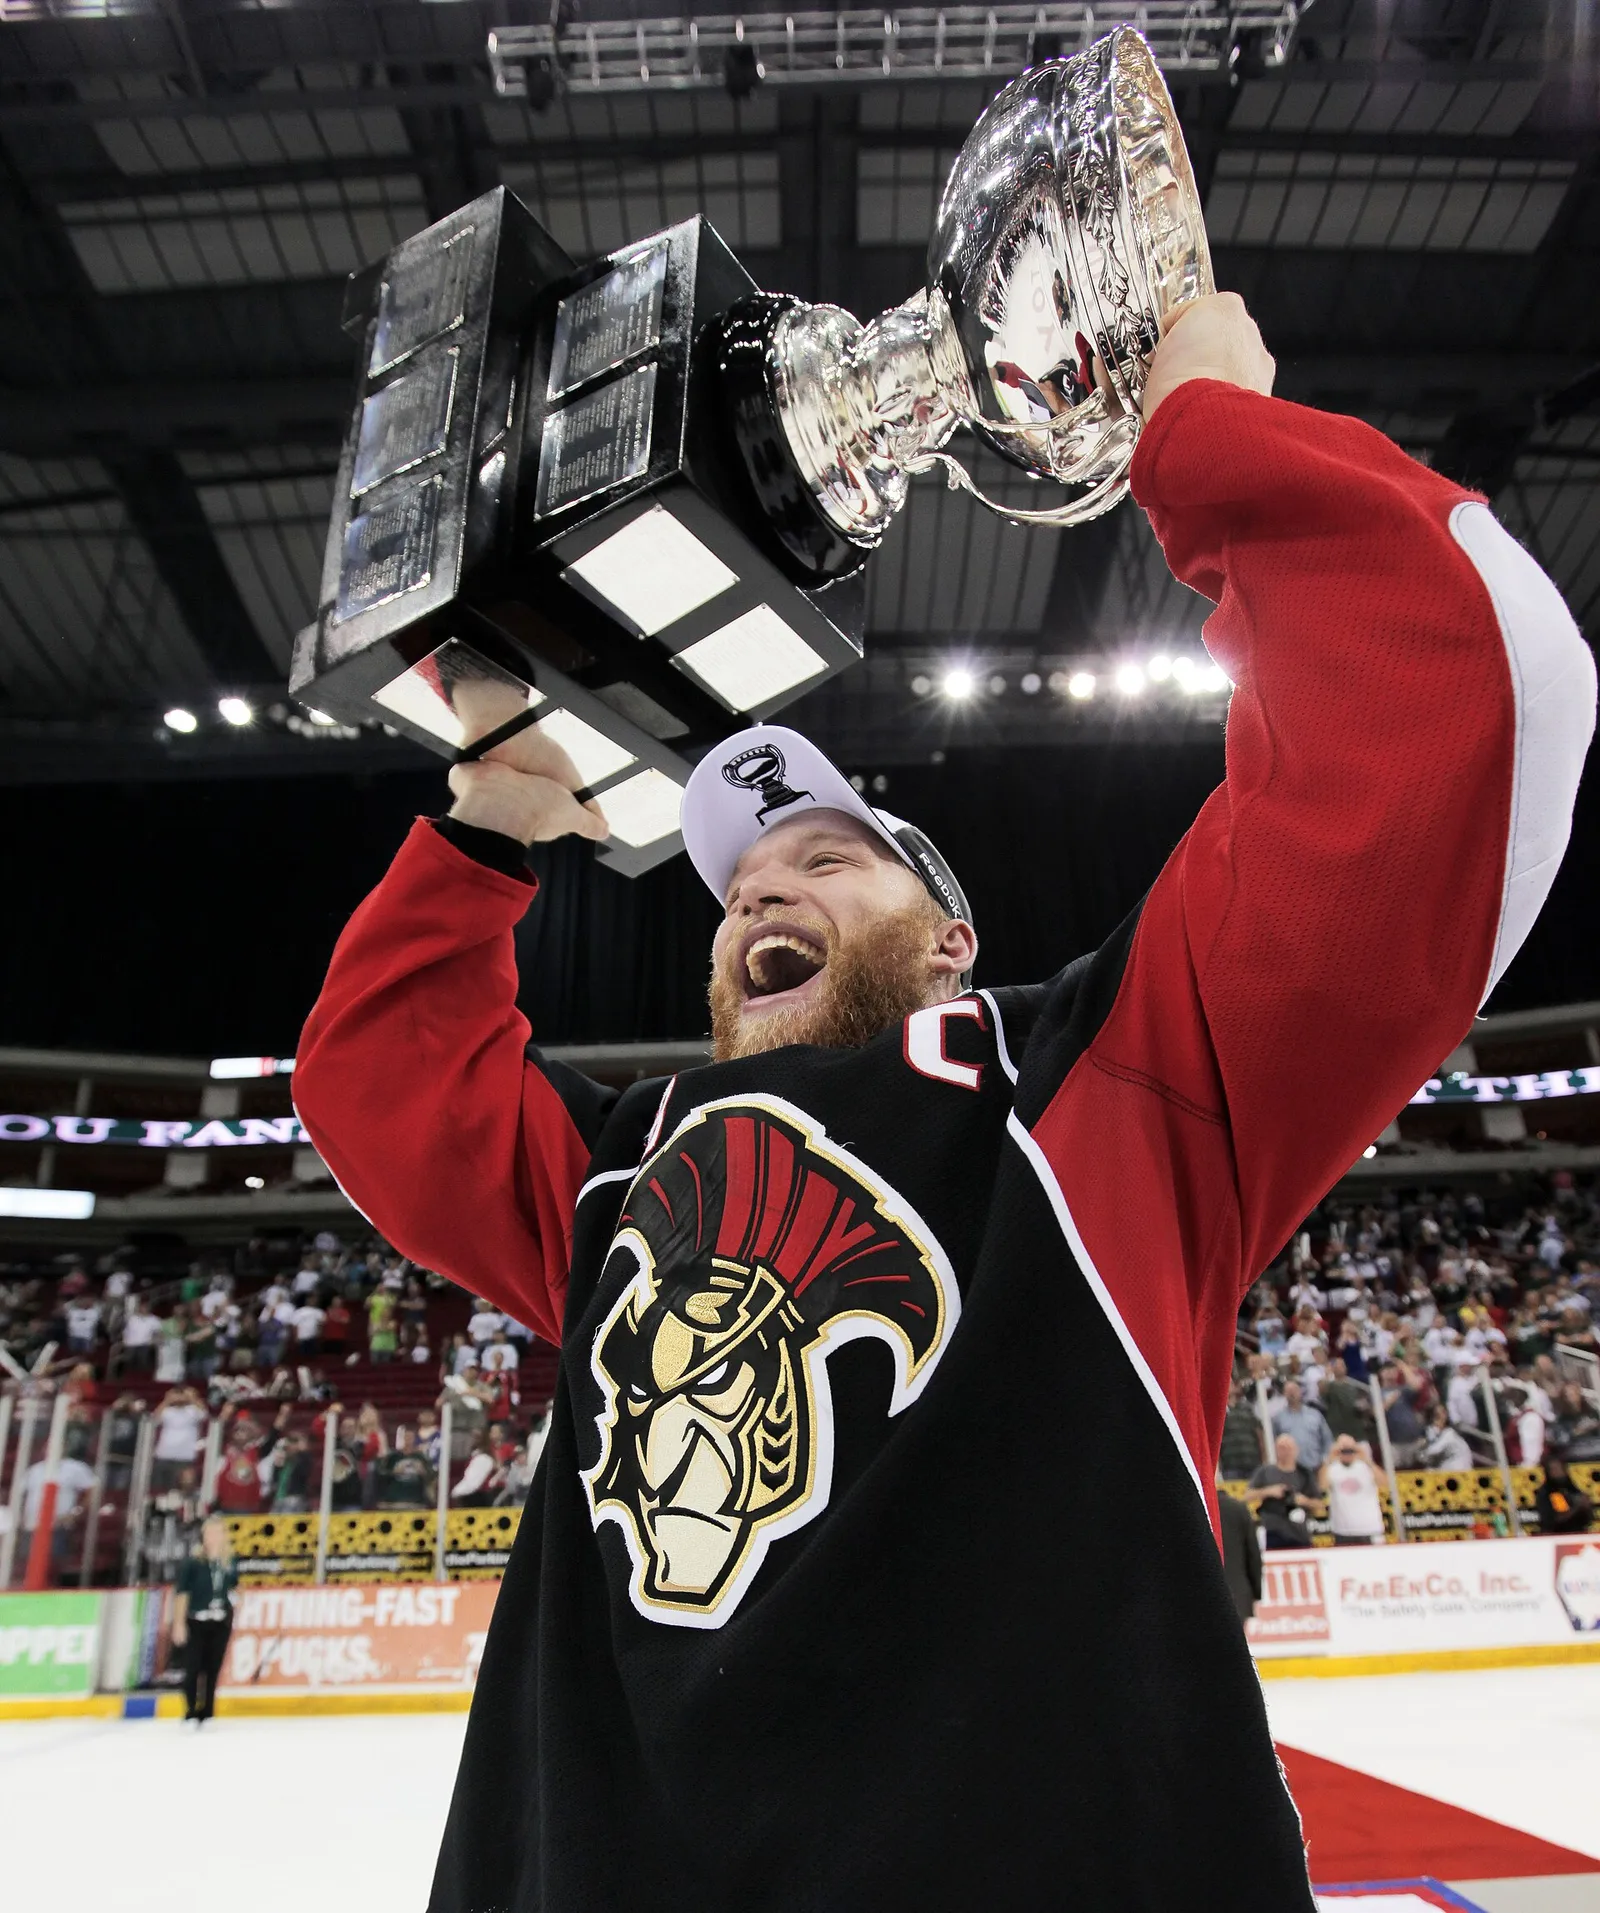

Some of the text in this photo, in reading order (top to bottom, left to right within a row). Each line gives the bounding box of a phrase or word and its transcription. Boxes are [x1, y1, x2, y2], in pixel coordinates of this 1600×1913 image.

[919, 852, 961, 919] Reebok
[903, 996, 986, 1093] C
[231, 1585, 462, 1631] HTNING-FAST
[1479, 1570, 1531, 1596] Inc.
